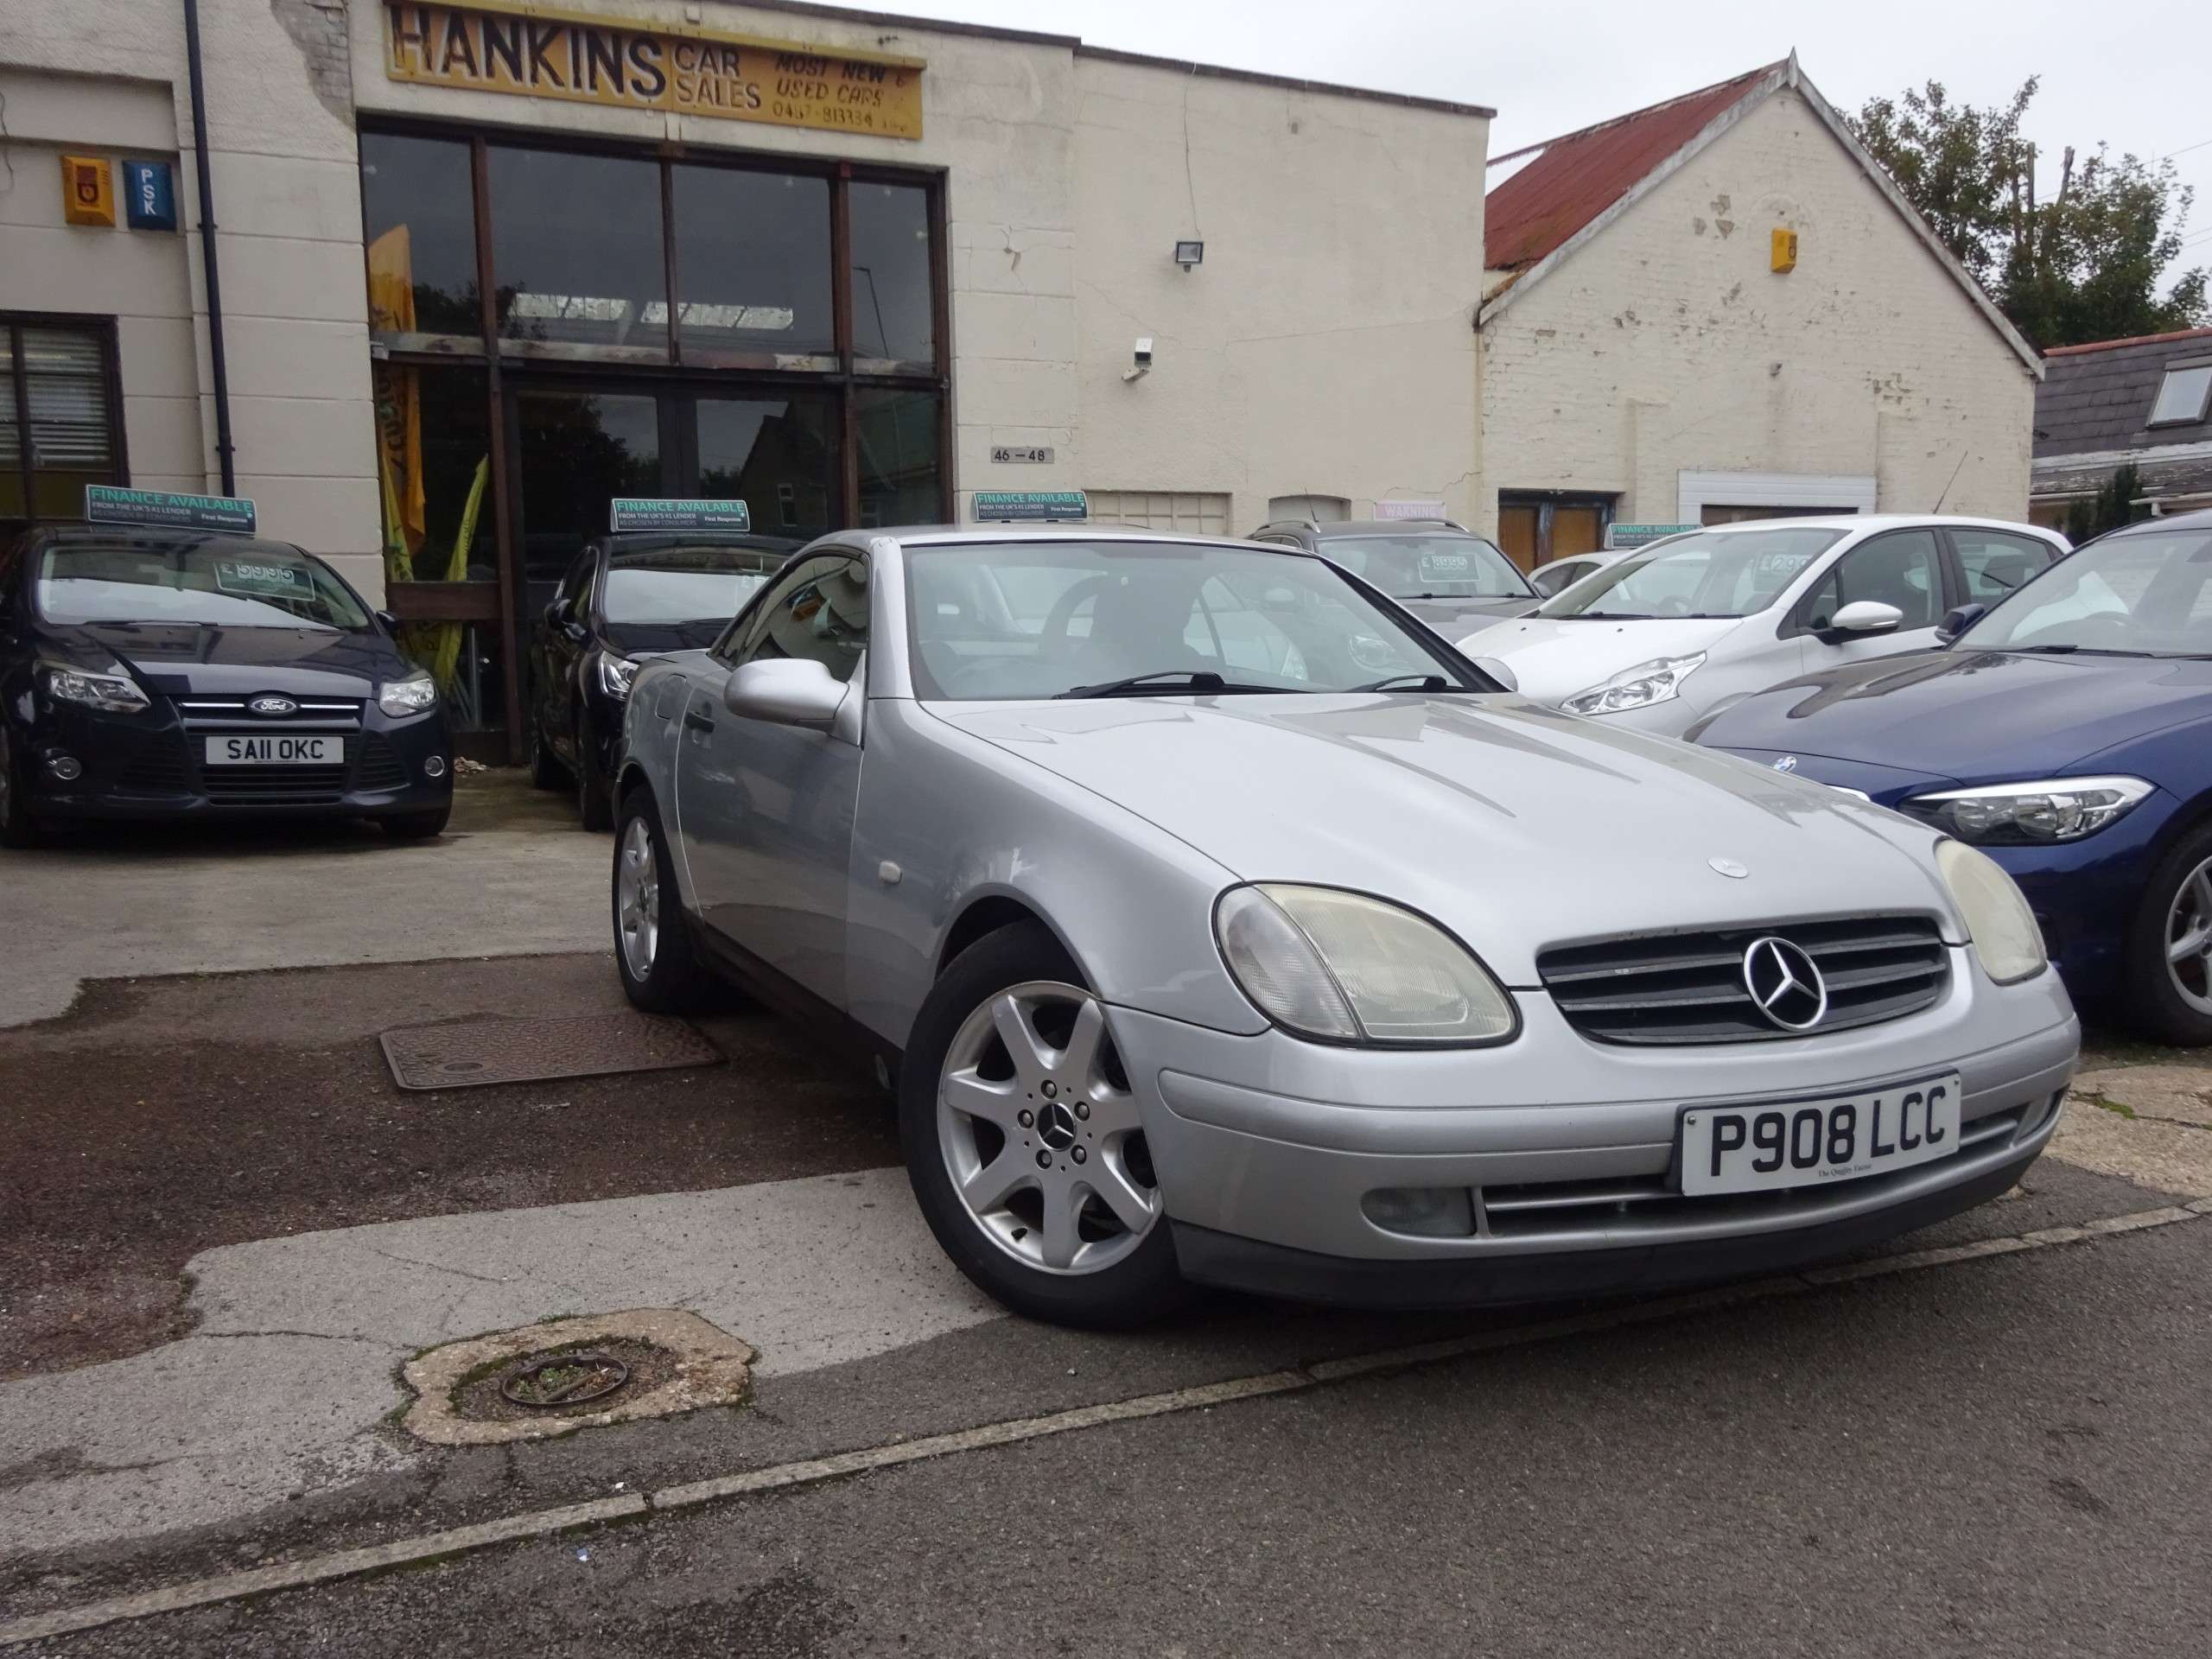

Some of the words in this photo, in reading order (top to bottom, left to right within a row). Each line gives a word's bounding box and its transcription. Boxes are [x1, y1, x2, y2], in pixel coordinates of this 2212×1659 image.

[391, 5, 666, 98] HANKINS
[674, 44, 741, 78] CAR
[775, 53, 830, 77] MOST
[842, 60, 886, 84] NEW
[677, 75, 761, 109] SALES
[777, 78, 830, 100] USED
[837, 84, 885, 108] CARS
[141, 168, 156, 215] PSK
[91, 488, 164, 505] FINANCE
[168, 496, 251, 512] AVAILABLE
[616, 501, 674, 512] FINANCE
[677, 502, 745, 512] AVAILABLE
[977, 493, 1025, 503] FINANCE
[1028, 493, 1084, 503] AVAILABLE
[260, 700, 287, 710] Ford
[227, 739, 271, 760] SA11
[278, 739, 324, 760] OKC
[1711, 1103, 1857, 1177] P908
[1871, 1085, 1946, 1159] LCC
